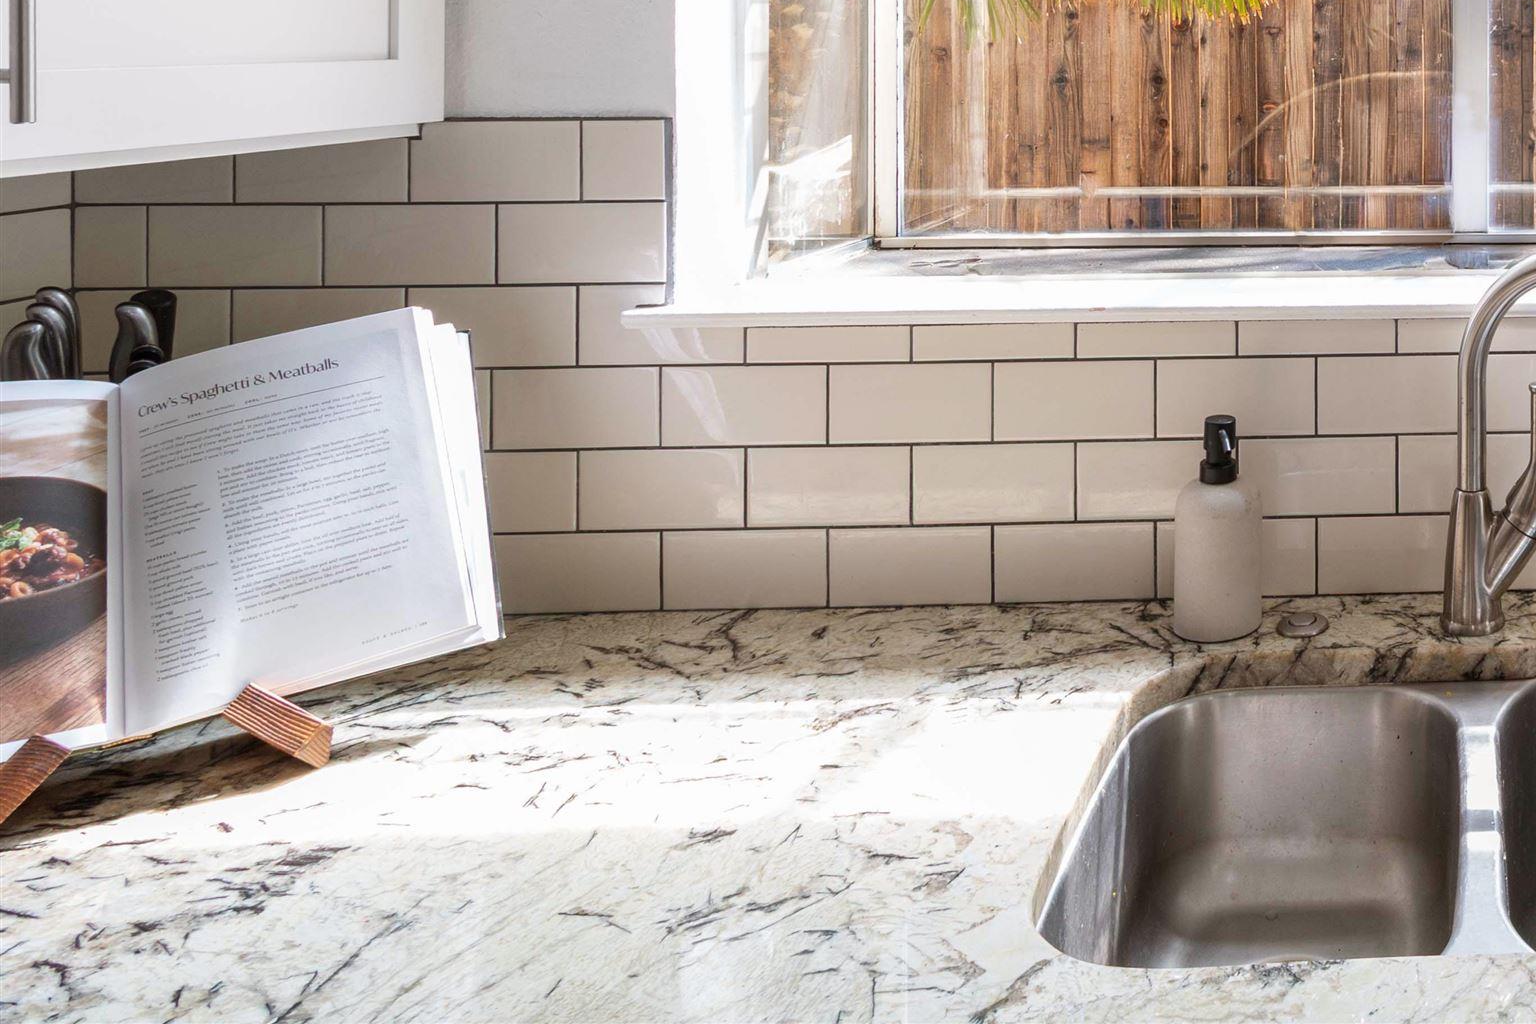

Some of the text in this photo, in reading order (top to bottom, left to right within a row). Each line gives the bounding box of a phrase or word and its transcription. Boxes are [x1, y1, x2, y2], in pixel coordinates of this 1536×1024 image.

[138, 396, 179, 418] Crew's
[180, 376, 250, 406] Spaghetti
[253, 374, 266, 387] &
[268, 357, 340, 384] Meatballs
